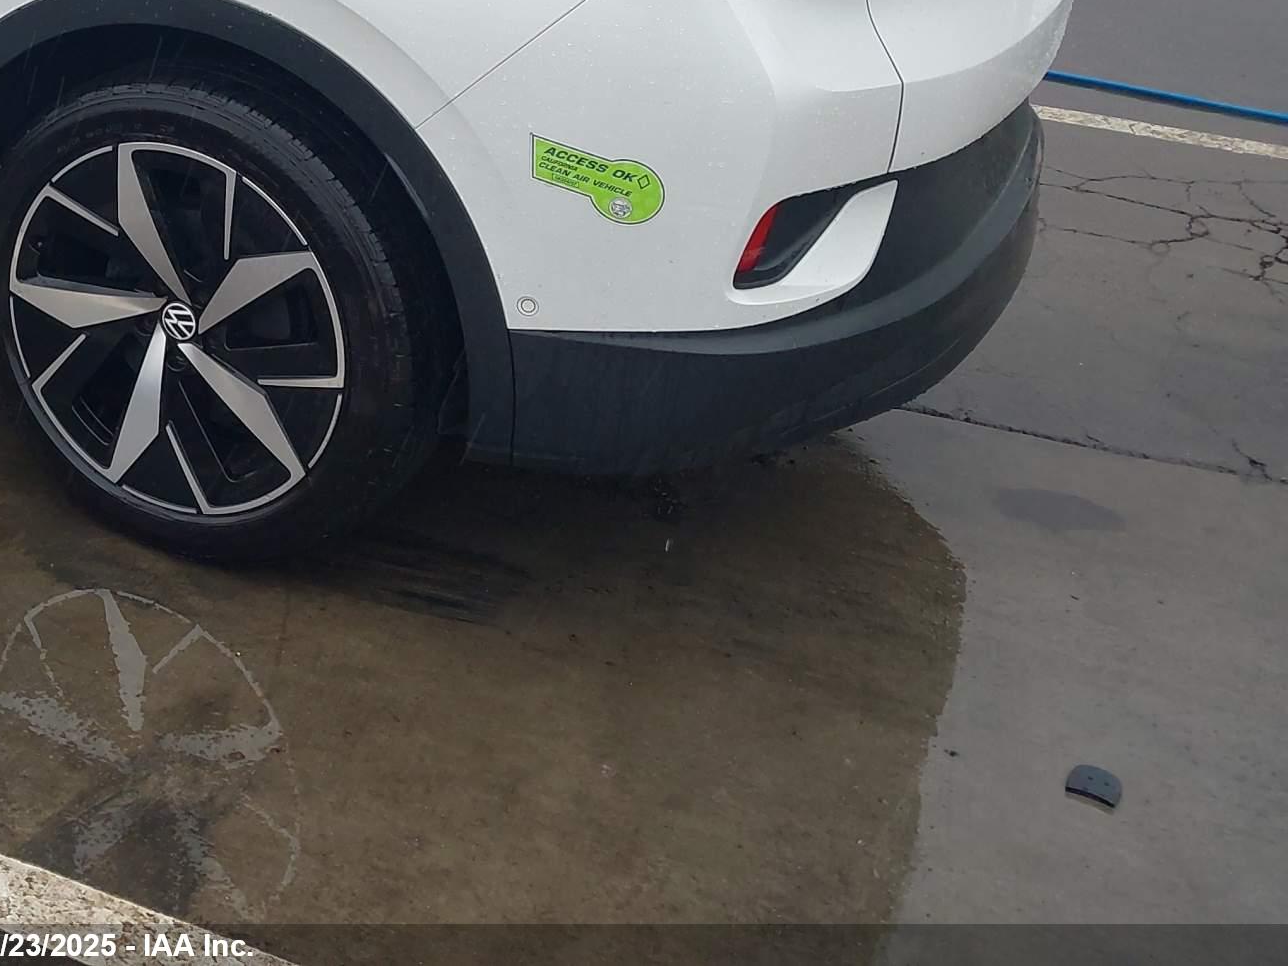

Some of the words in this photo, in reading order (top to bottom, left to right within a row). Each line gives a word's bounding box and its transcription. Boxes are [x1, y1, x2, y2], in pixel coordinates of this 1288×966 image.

[538, 162, 571, 177] CLEAN
[572, 174, 590, 183] AIR
[593, 180, 632, 197] VEHICLE
[541, 155, 578, 172] CALIFORNIA
[543, 147, 609, 173] ACCESS
[612, 169, 638, 183] OK
